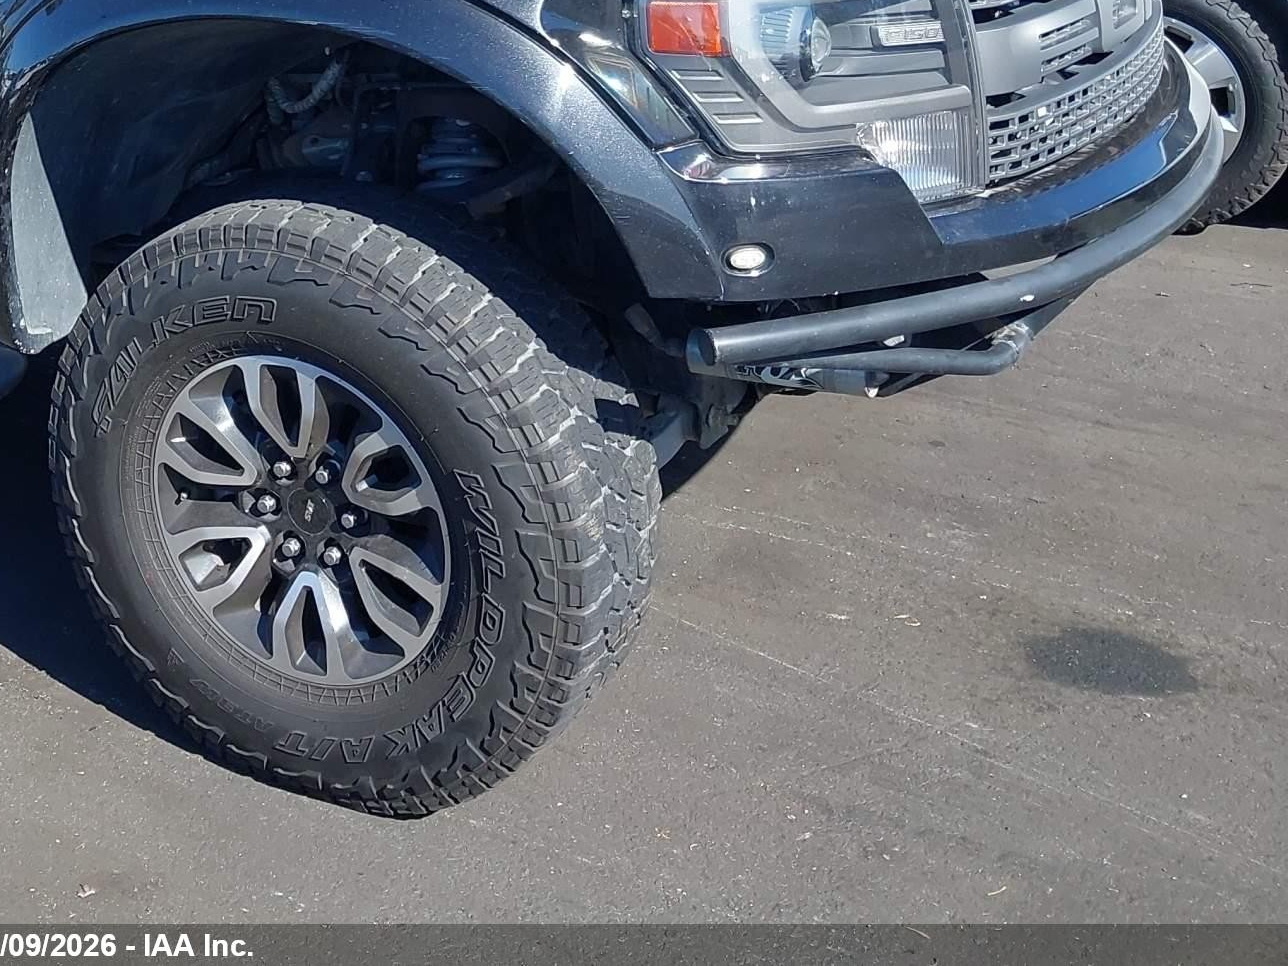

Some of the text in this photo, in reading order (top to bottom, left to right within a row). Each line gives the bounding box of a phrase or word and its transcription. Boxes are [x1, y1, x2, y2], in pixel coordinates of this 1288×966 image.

[91, 295, 278, 438] FALKEN
[274, 468, 506, 764] WILDPEAK A/T
